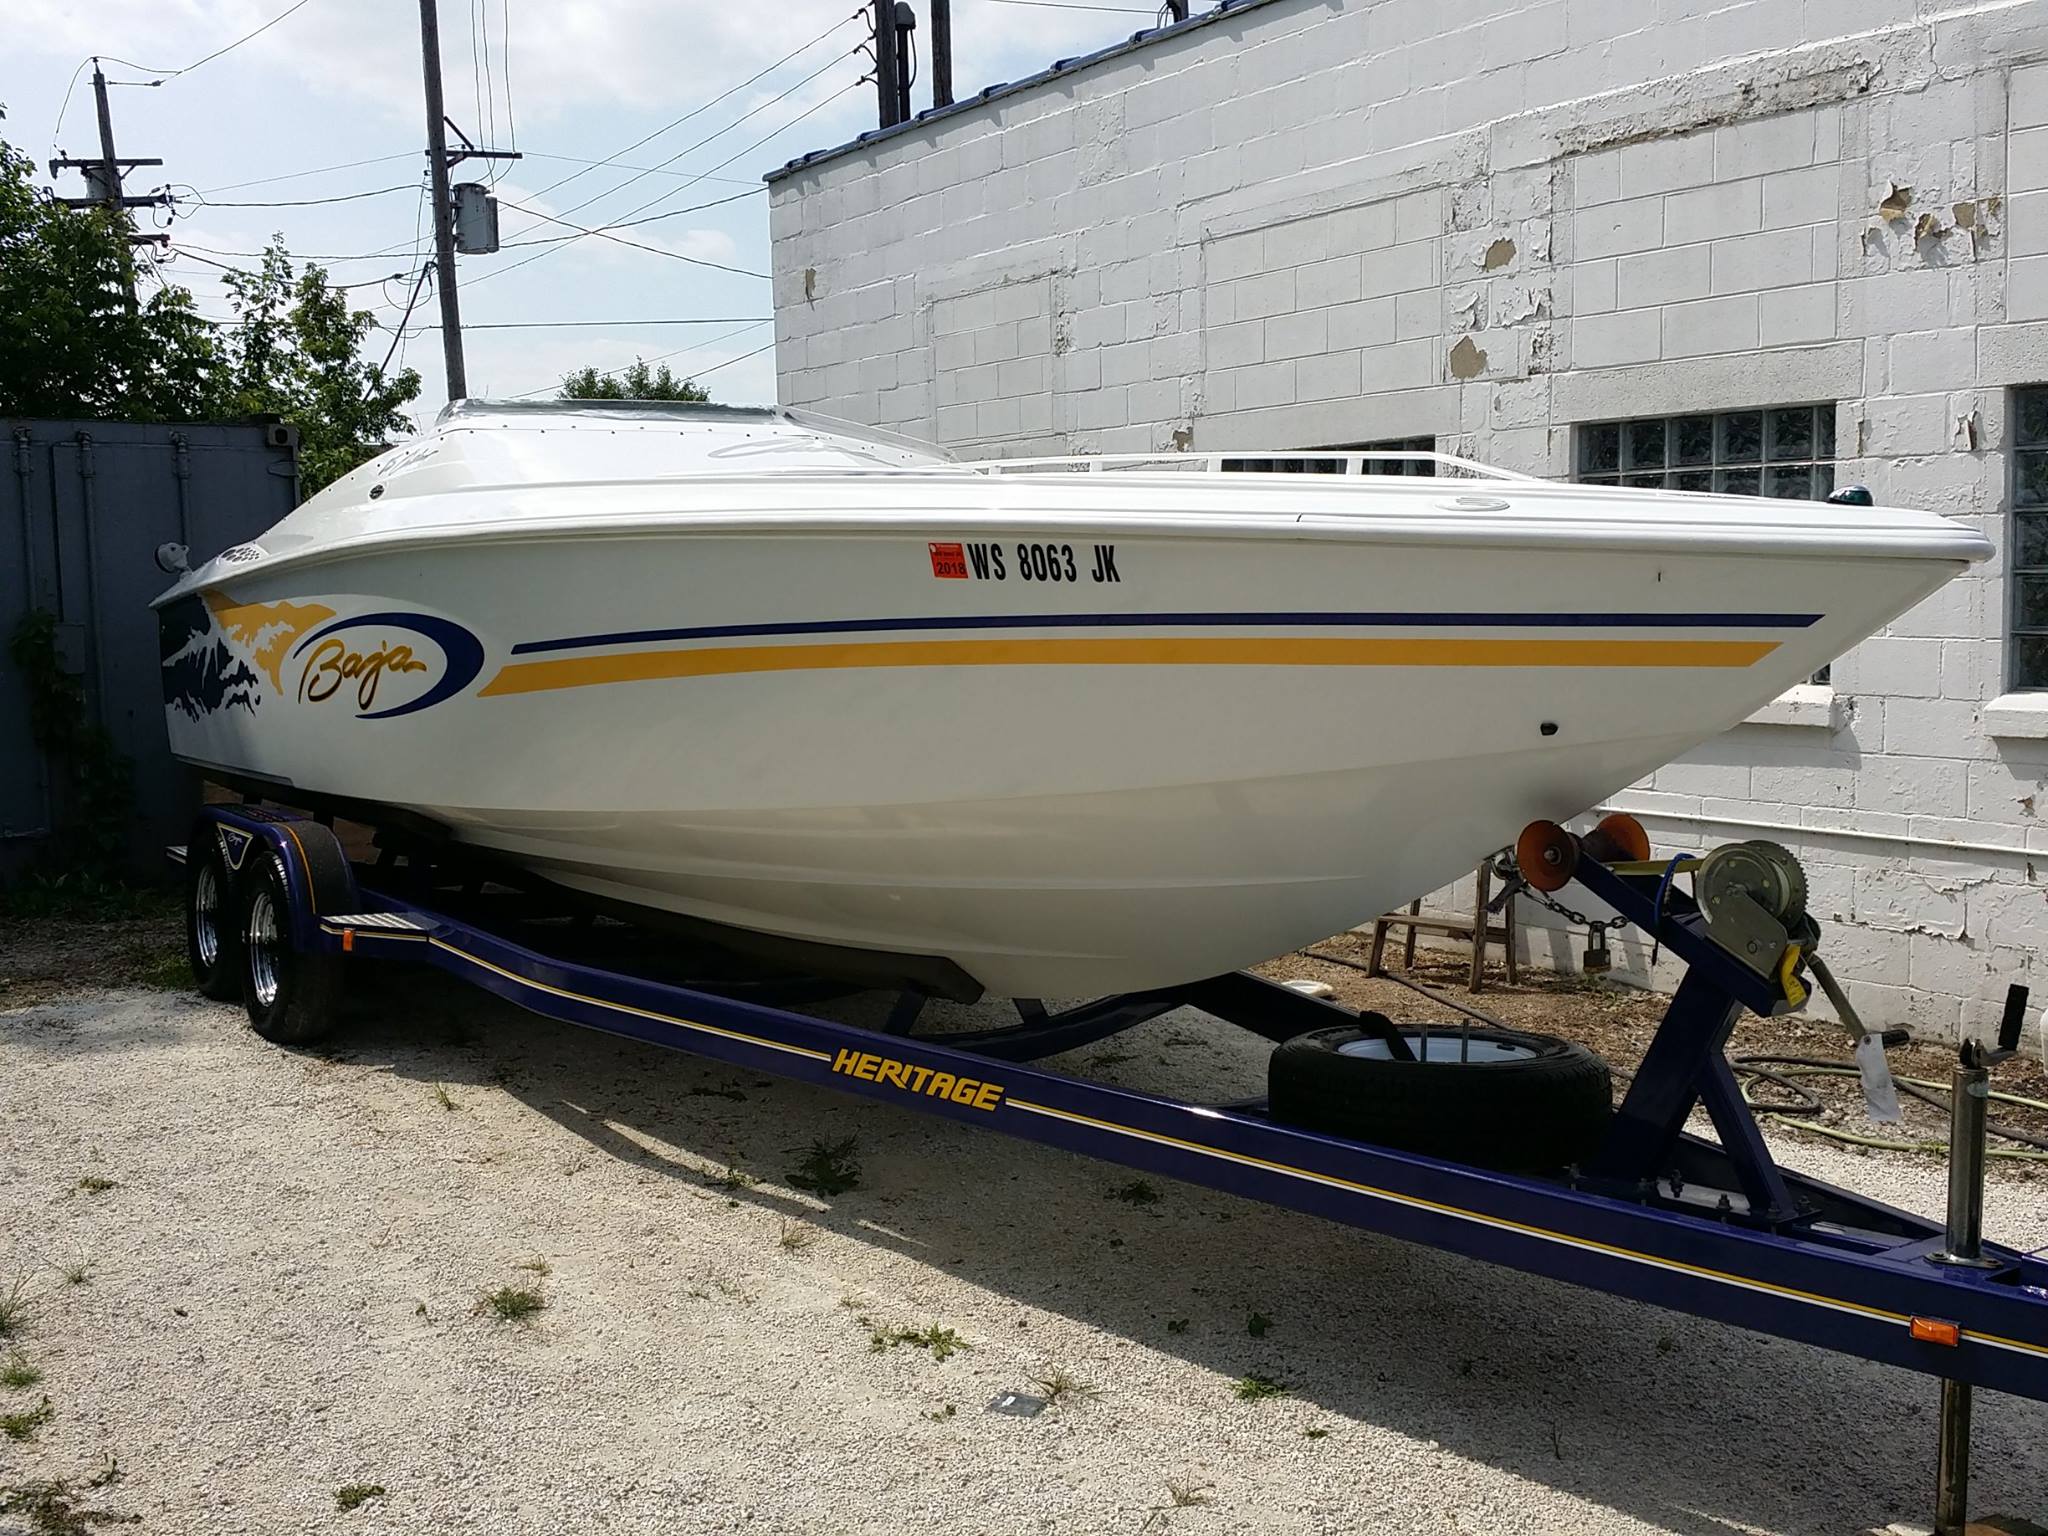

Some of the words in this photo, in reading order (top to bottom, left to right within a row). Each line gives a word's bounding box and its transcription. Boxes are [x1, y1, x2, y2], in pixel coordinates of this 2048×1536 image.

[937, 562, 966, 575] 2018
[967, 544, 1006, 581] WS
[1017, 544, 1077, 582] 8063
[1091, 545, 1121, 582] JK
[297, 638, 427, 711] Baja
[832, 1048, 1005, 1112] HERITAGE
